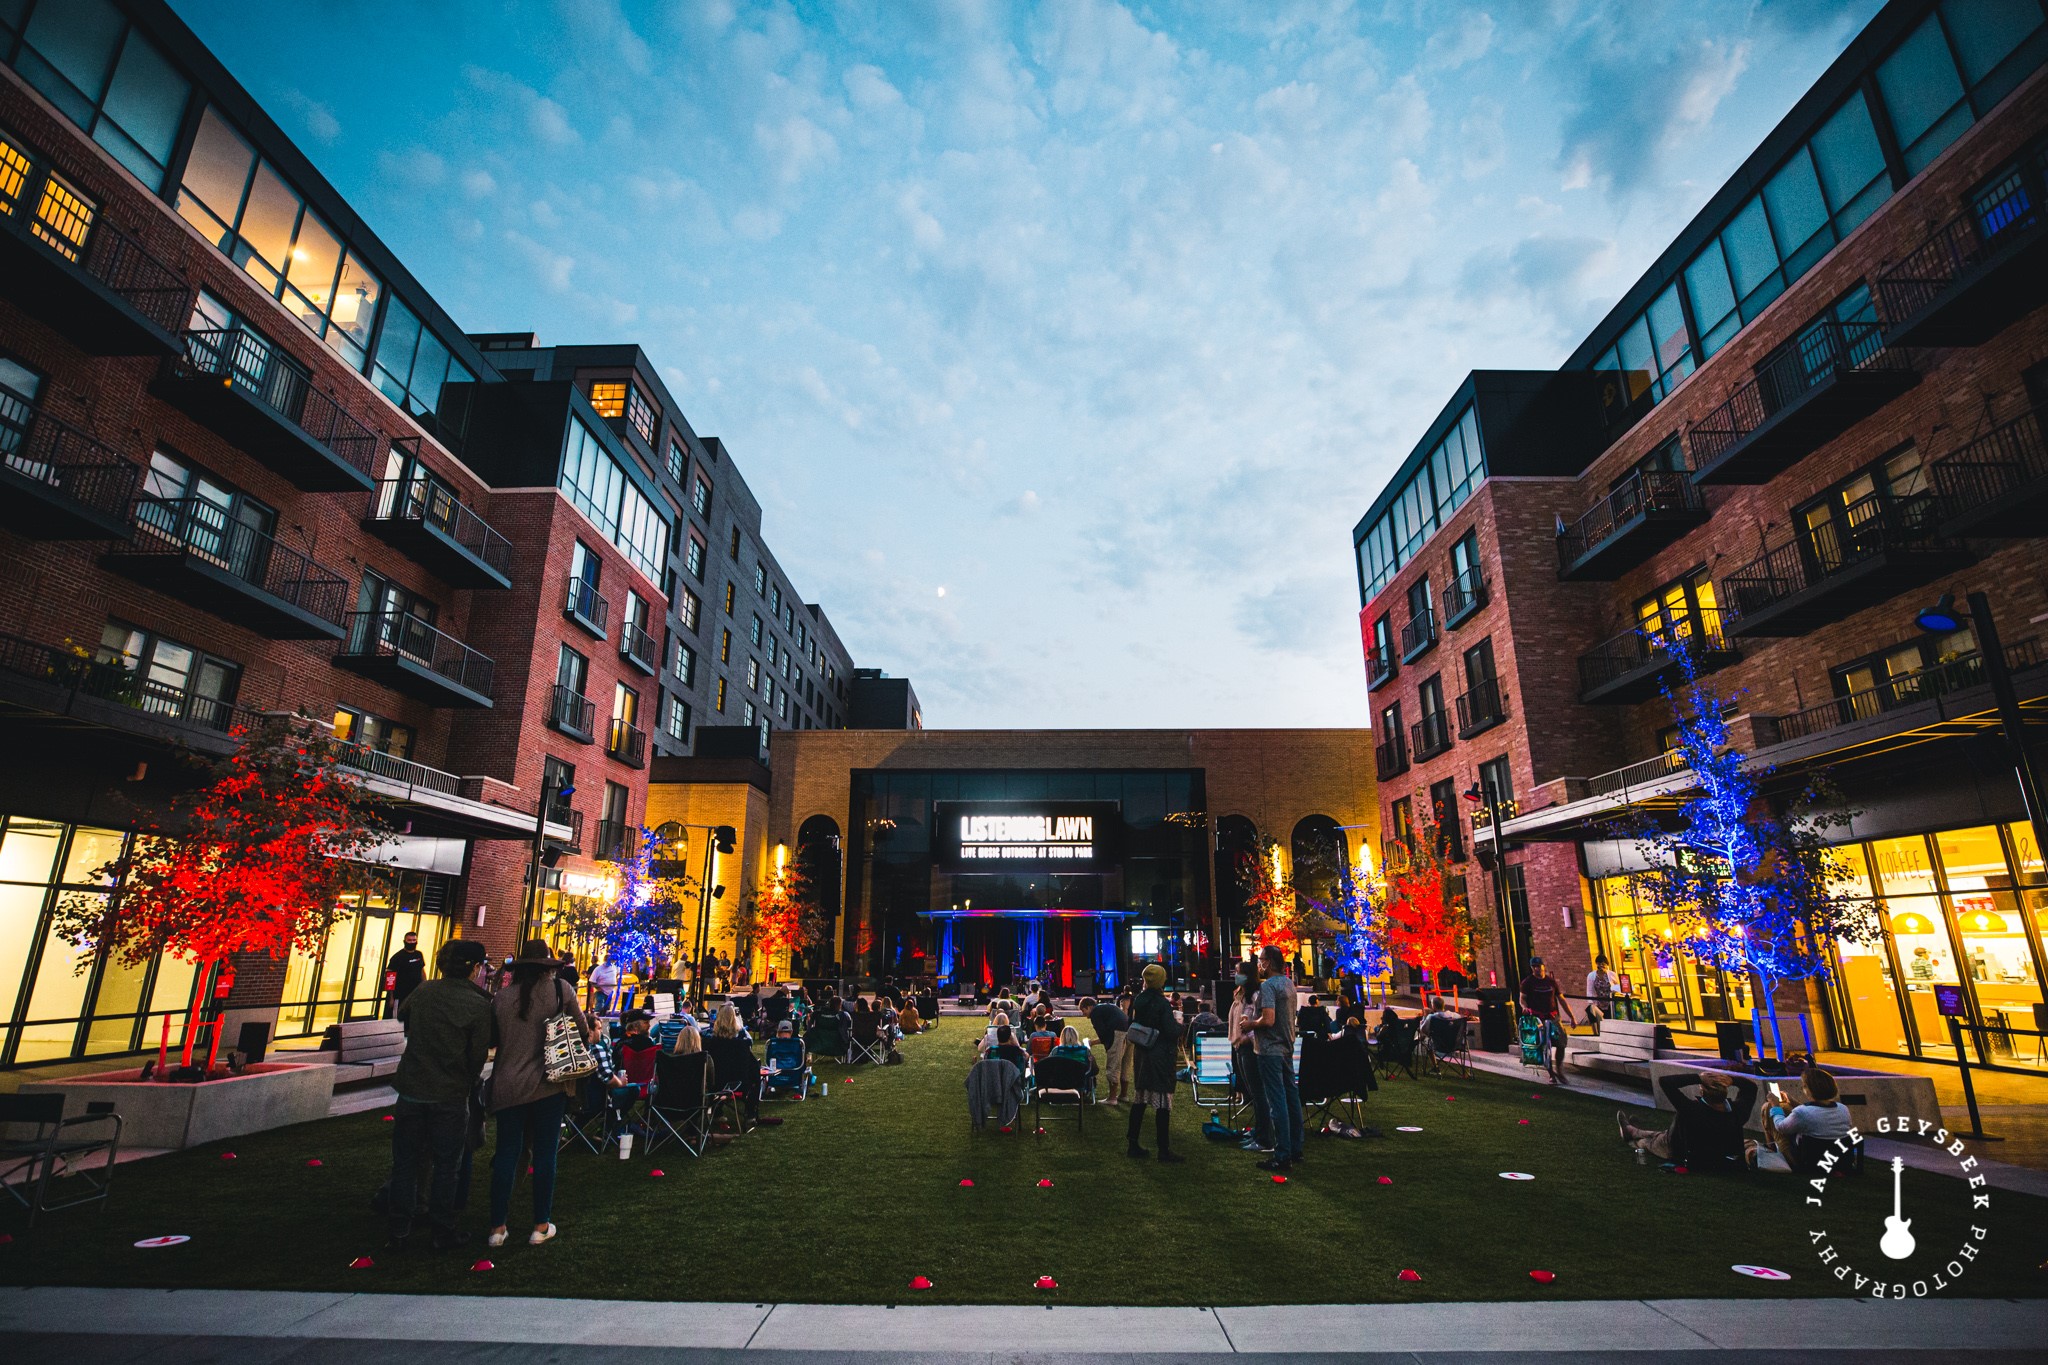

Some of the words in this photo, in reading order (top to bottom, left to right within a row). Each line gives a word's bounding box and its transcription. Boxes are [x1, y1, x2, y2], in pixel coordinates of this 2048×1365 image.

[1045, 816, 1093, 840] LAWN
[961, 847, 976, 858] LIVE
[978, 847, 1000, 858] MUSIC
[1001, 847, 1037, 858] OUTDOORS
[1038, 847, 1047, 858] AT
[1048, 847, 1073, 858] STUDIO
[1074, 847, 1093, 858] PARK
[1879, 850, 1926, 883] COFFEE
